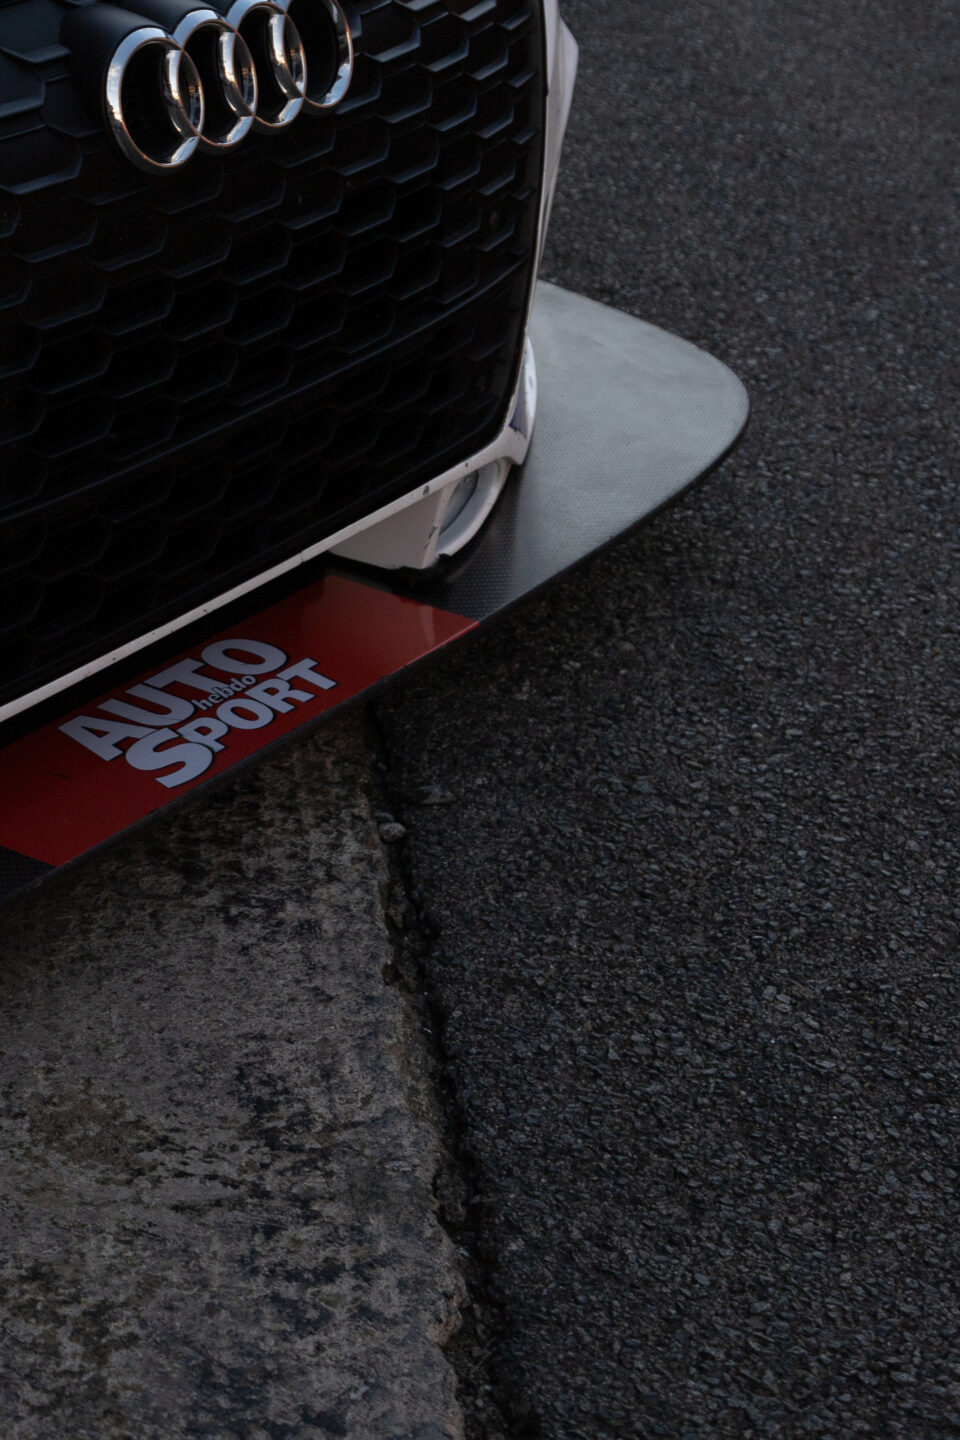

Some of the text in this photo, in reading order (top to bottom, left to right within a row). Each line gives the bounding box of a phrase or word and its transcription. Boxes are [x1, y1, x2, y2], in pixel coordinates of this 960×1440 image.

[57, 638, 289, 763] AUTO
[125, 657, 338, 790] SPORT
[191, 674, 258, 711] hebdo
